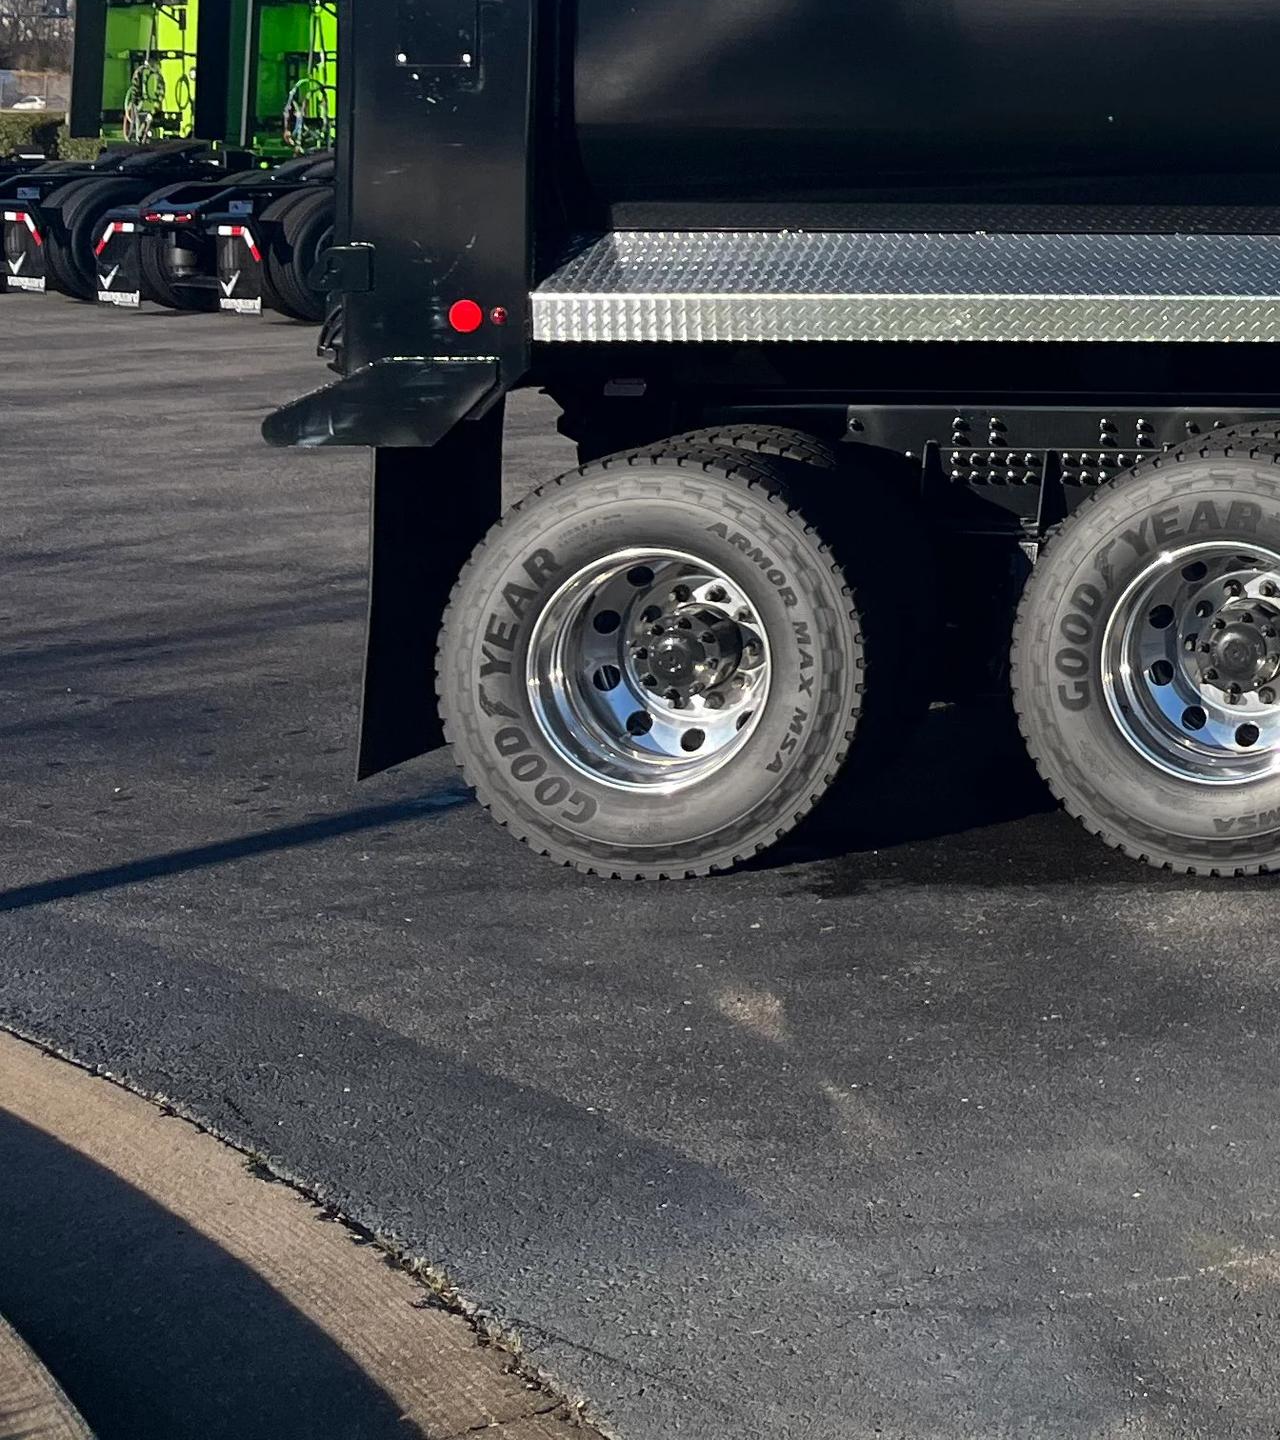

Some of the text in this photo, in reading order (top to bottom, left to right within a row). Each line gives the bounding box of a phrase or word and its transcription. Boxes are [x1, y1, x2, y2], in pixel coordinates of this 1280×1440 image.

[479, 548, 598, 824] GOODYEAR
[705, 522, 814, 773] ARMOR MAX MSA
[1055, 499, 1263, 711] GOODYEAR
